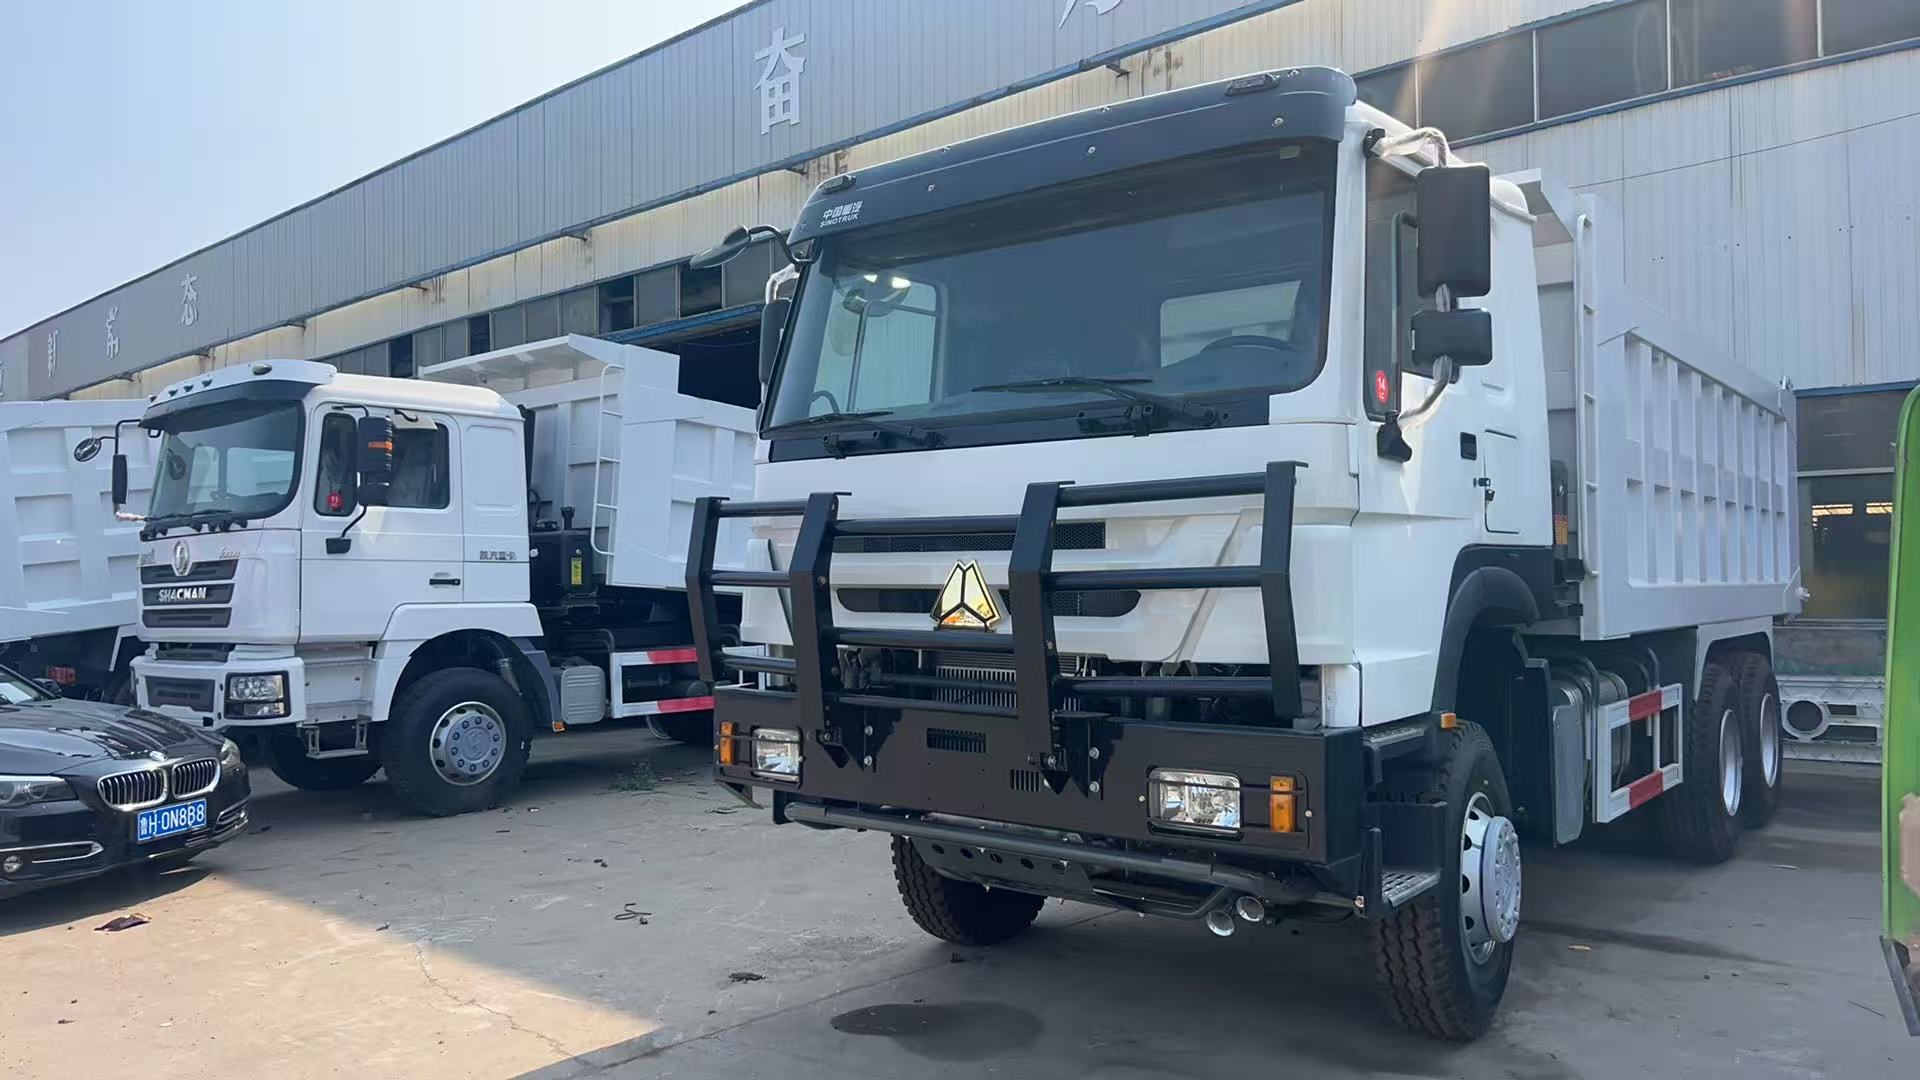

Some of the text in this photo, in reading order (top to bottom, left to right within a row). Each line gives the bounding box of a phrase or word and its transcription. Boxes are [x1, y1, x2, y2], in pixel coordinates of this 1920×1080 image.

[753, 26, 806, 135] 奋
[820, 212, 859, 228] SINOTRUK
[159, 587, 207, 602] SHACMAN
